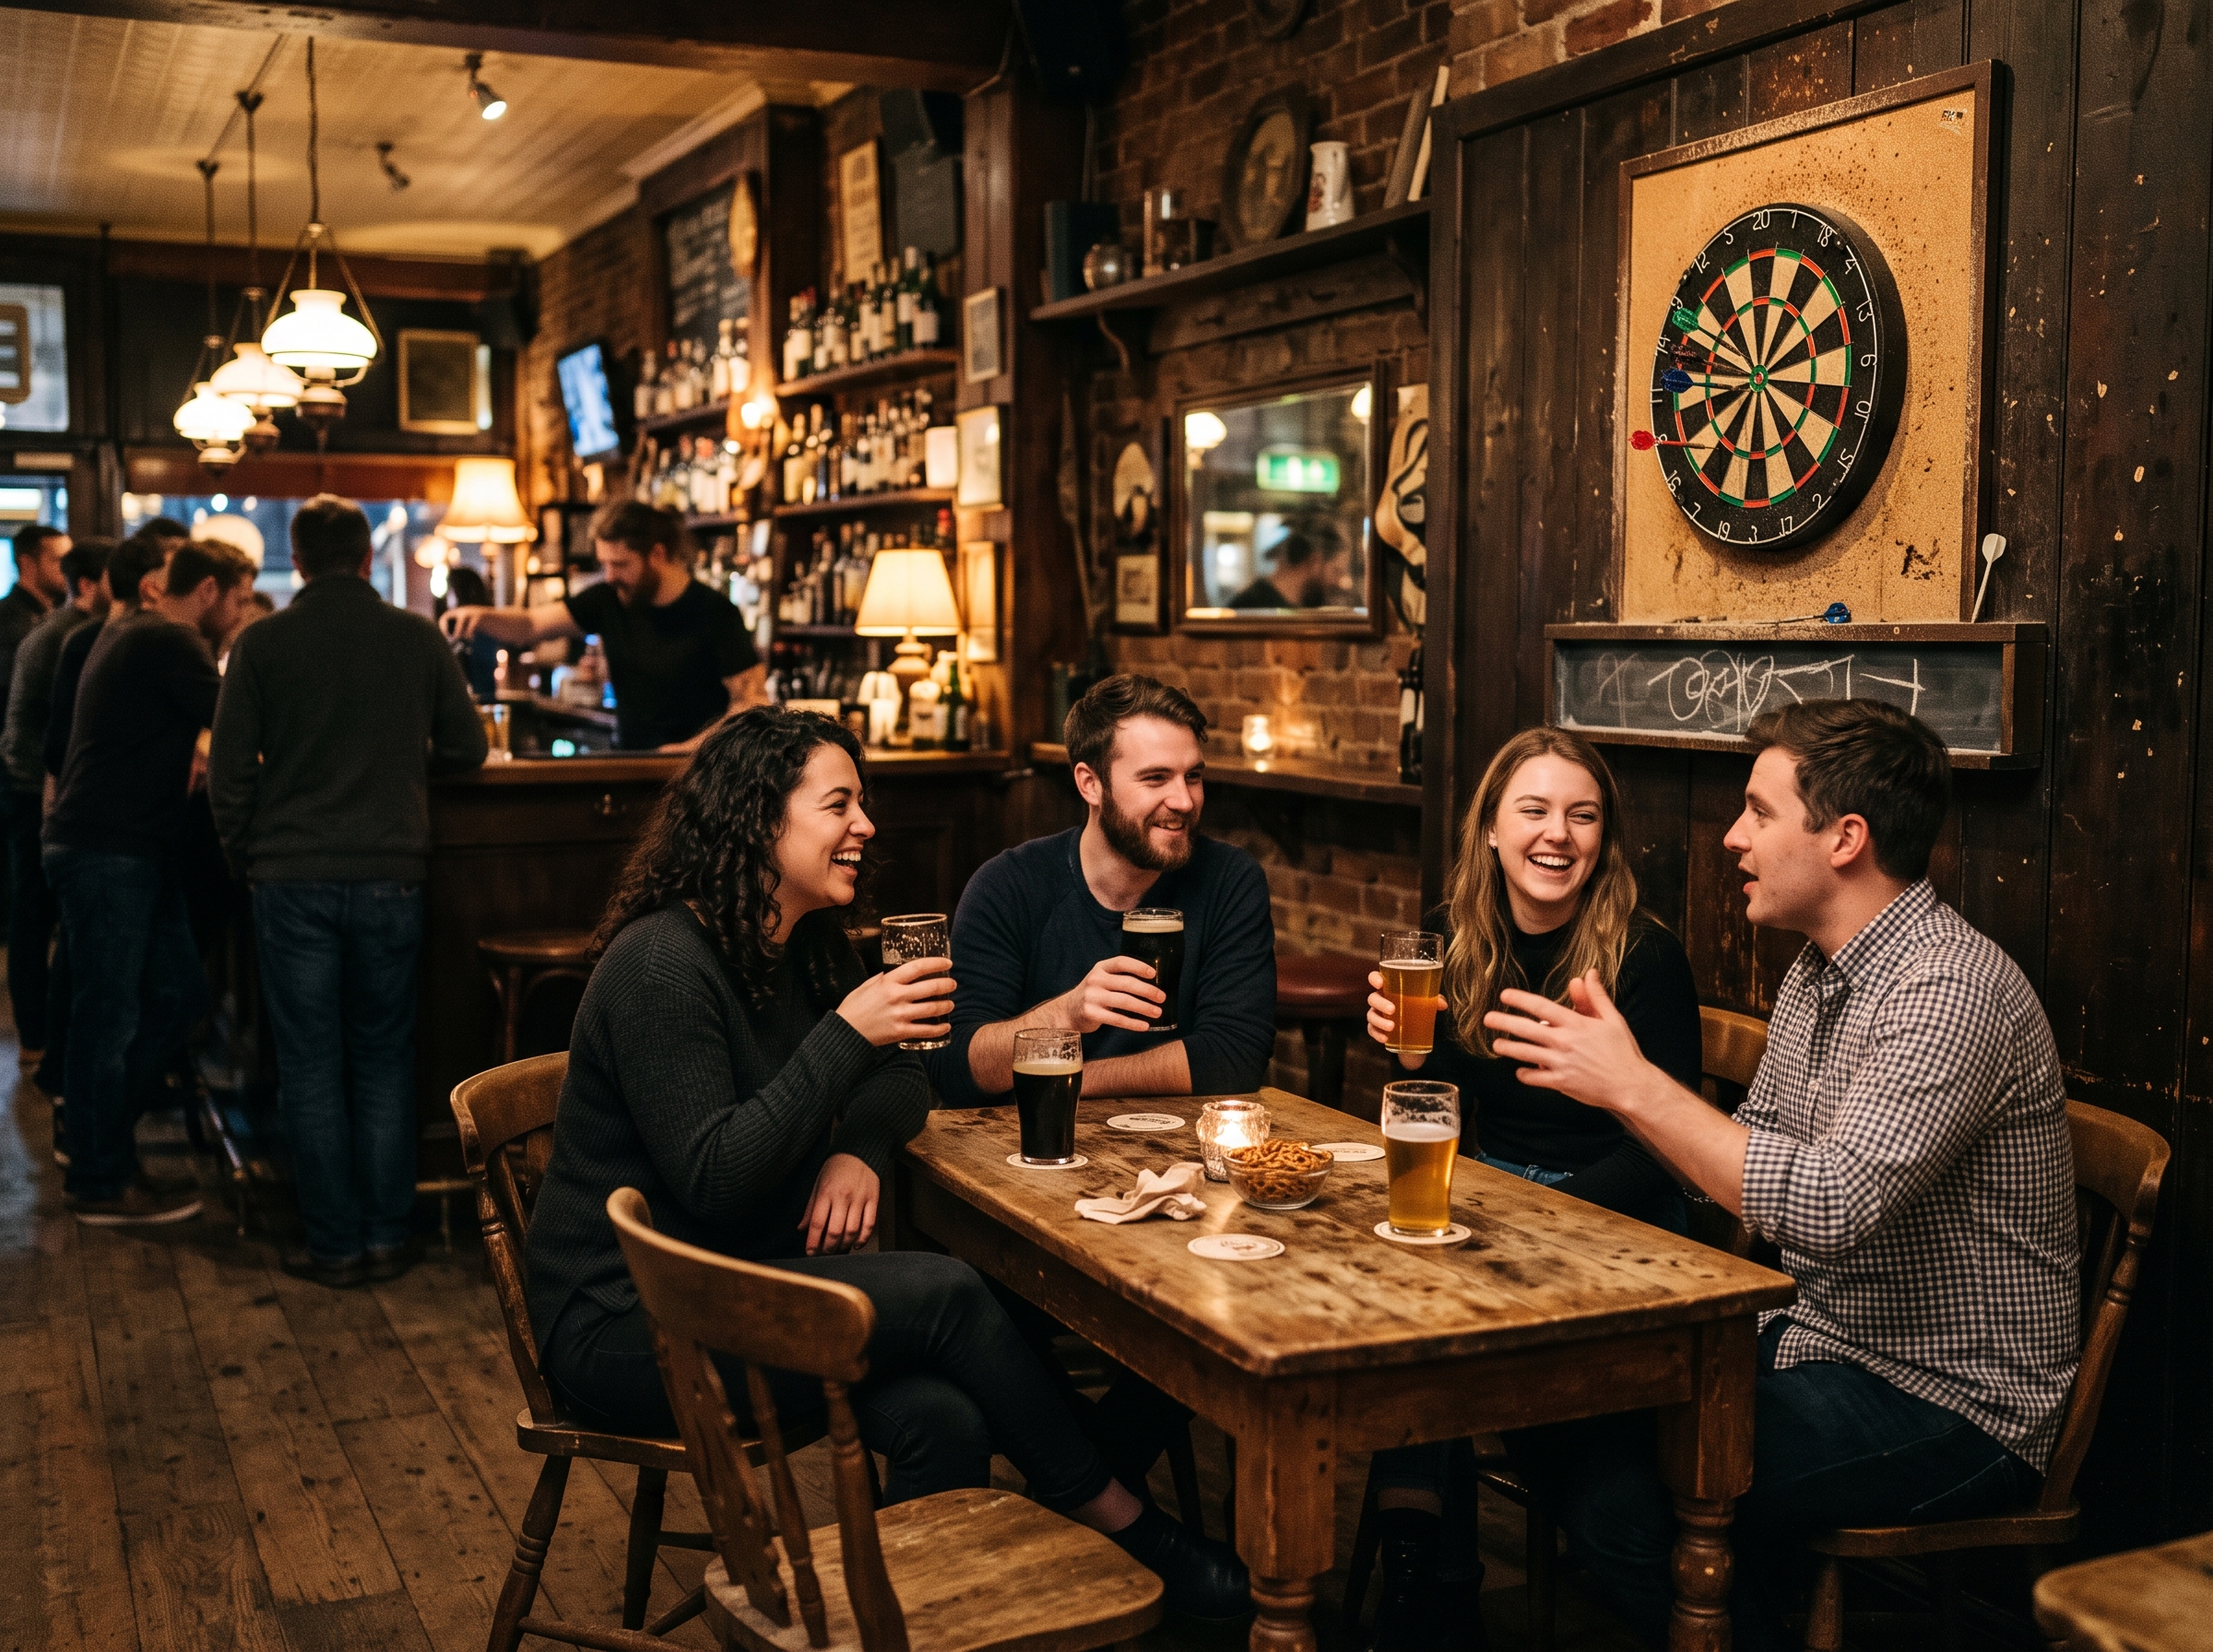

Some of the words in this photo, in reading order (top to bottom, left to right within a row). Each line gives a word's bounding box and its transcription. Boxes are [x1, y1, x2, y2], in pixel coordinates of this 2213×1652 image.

[1752, 209, 1770, 230] 20
[1723, 228, 1734, 245] 5
[1817, 223, 1833, 247] 18
[1691, 251, 1710, 274] 12
[1845, 258, 1857, 275] 4
[1856, 299, 1874, 323] 13
[1657, 334, 1671, 355] 14
[1860, 354, 1877, 367] 6
[1651, 388, 1663, 403] 11
[1854, 400, 1871, 424] 10
[1837, 448, 1854, 474] 15
[1666, 469, 1682, 491] 16
[1690, 502, 1701, 520] 7
[1812, 493, 1822, 510] 2
[1717, 520, 1731, 541] 19
[1748, 525, 1757, 544] 3
[1779, 515, 1793, 537] 17
